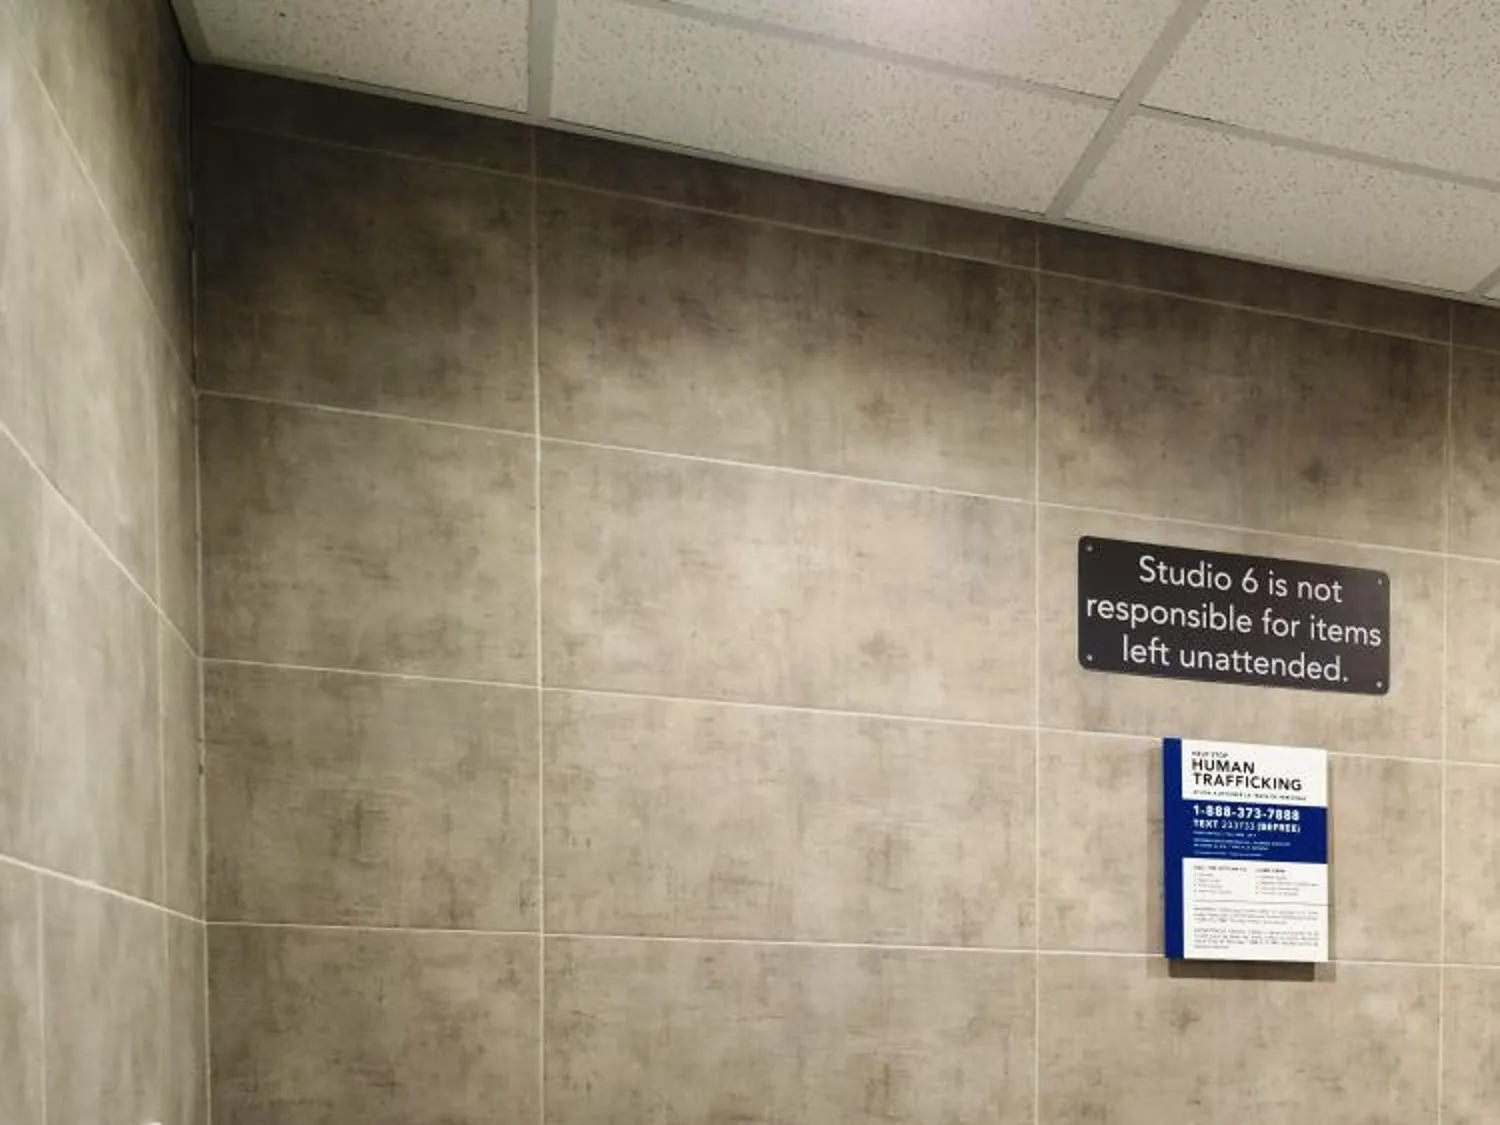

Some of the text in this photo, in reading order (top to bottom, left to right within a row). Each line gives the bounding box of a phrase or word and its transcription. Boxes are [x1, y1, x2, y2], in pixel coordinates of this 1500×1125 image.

[1138, 555, 1343, 603] Studio 6 is not
[1086, 598, 1382, 647] responsible for items
[1122, 634, 1349, 683] left unattended.
[1192, 758, 1255, 774] HUMAN
[1193, 772, 1303, 791] TRAFFICKING
[1193, 804, 1301, 821] 1-888-373-7888
[1193, 819, 1219, 829] TEXT
